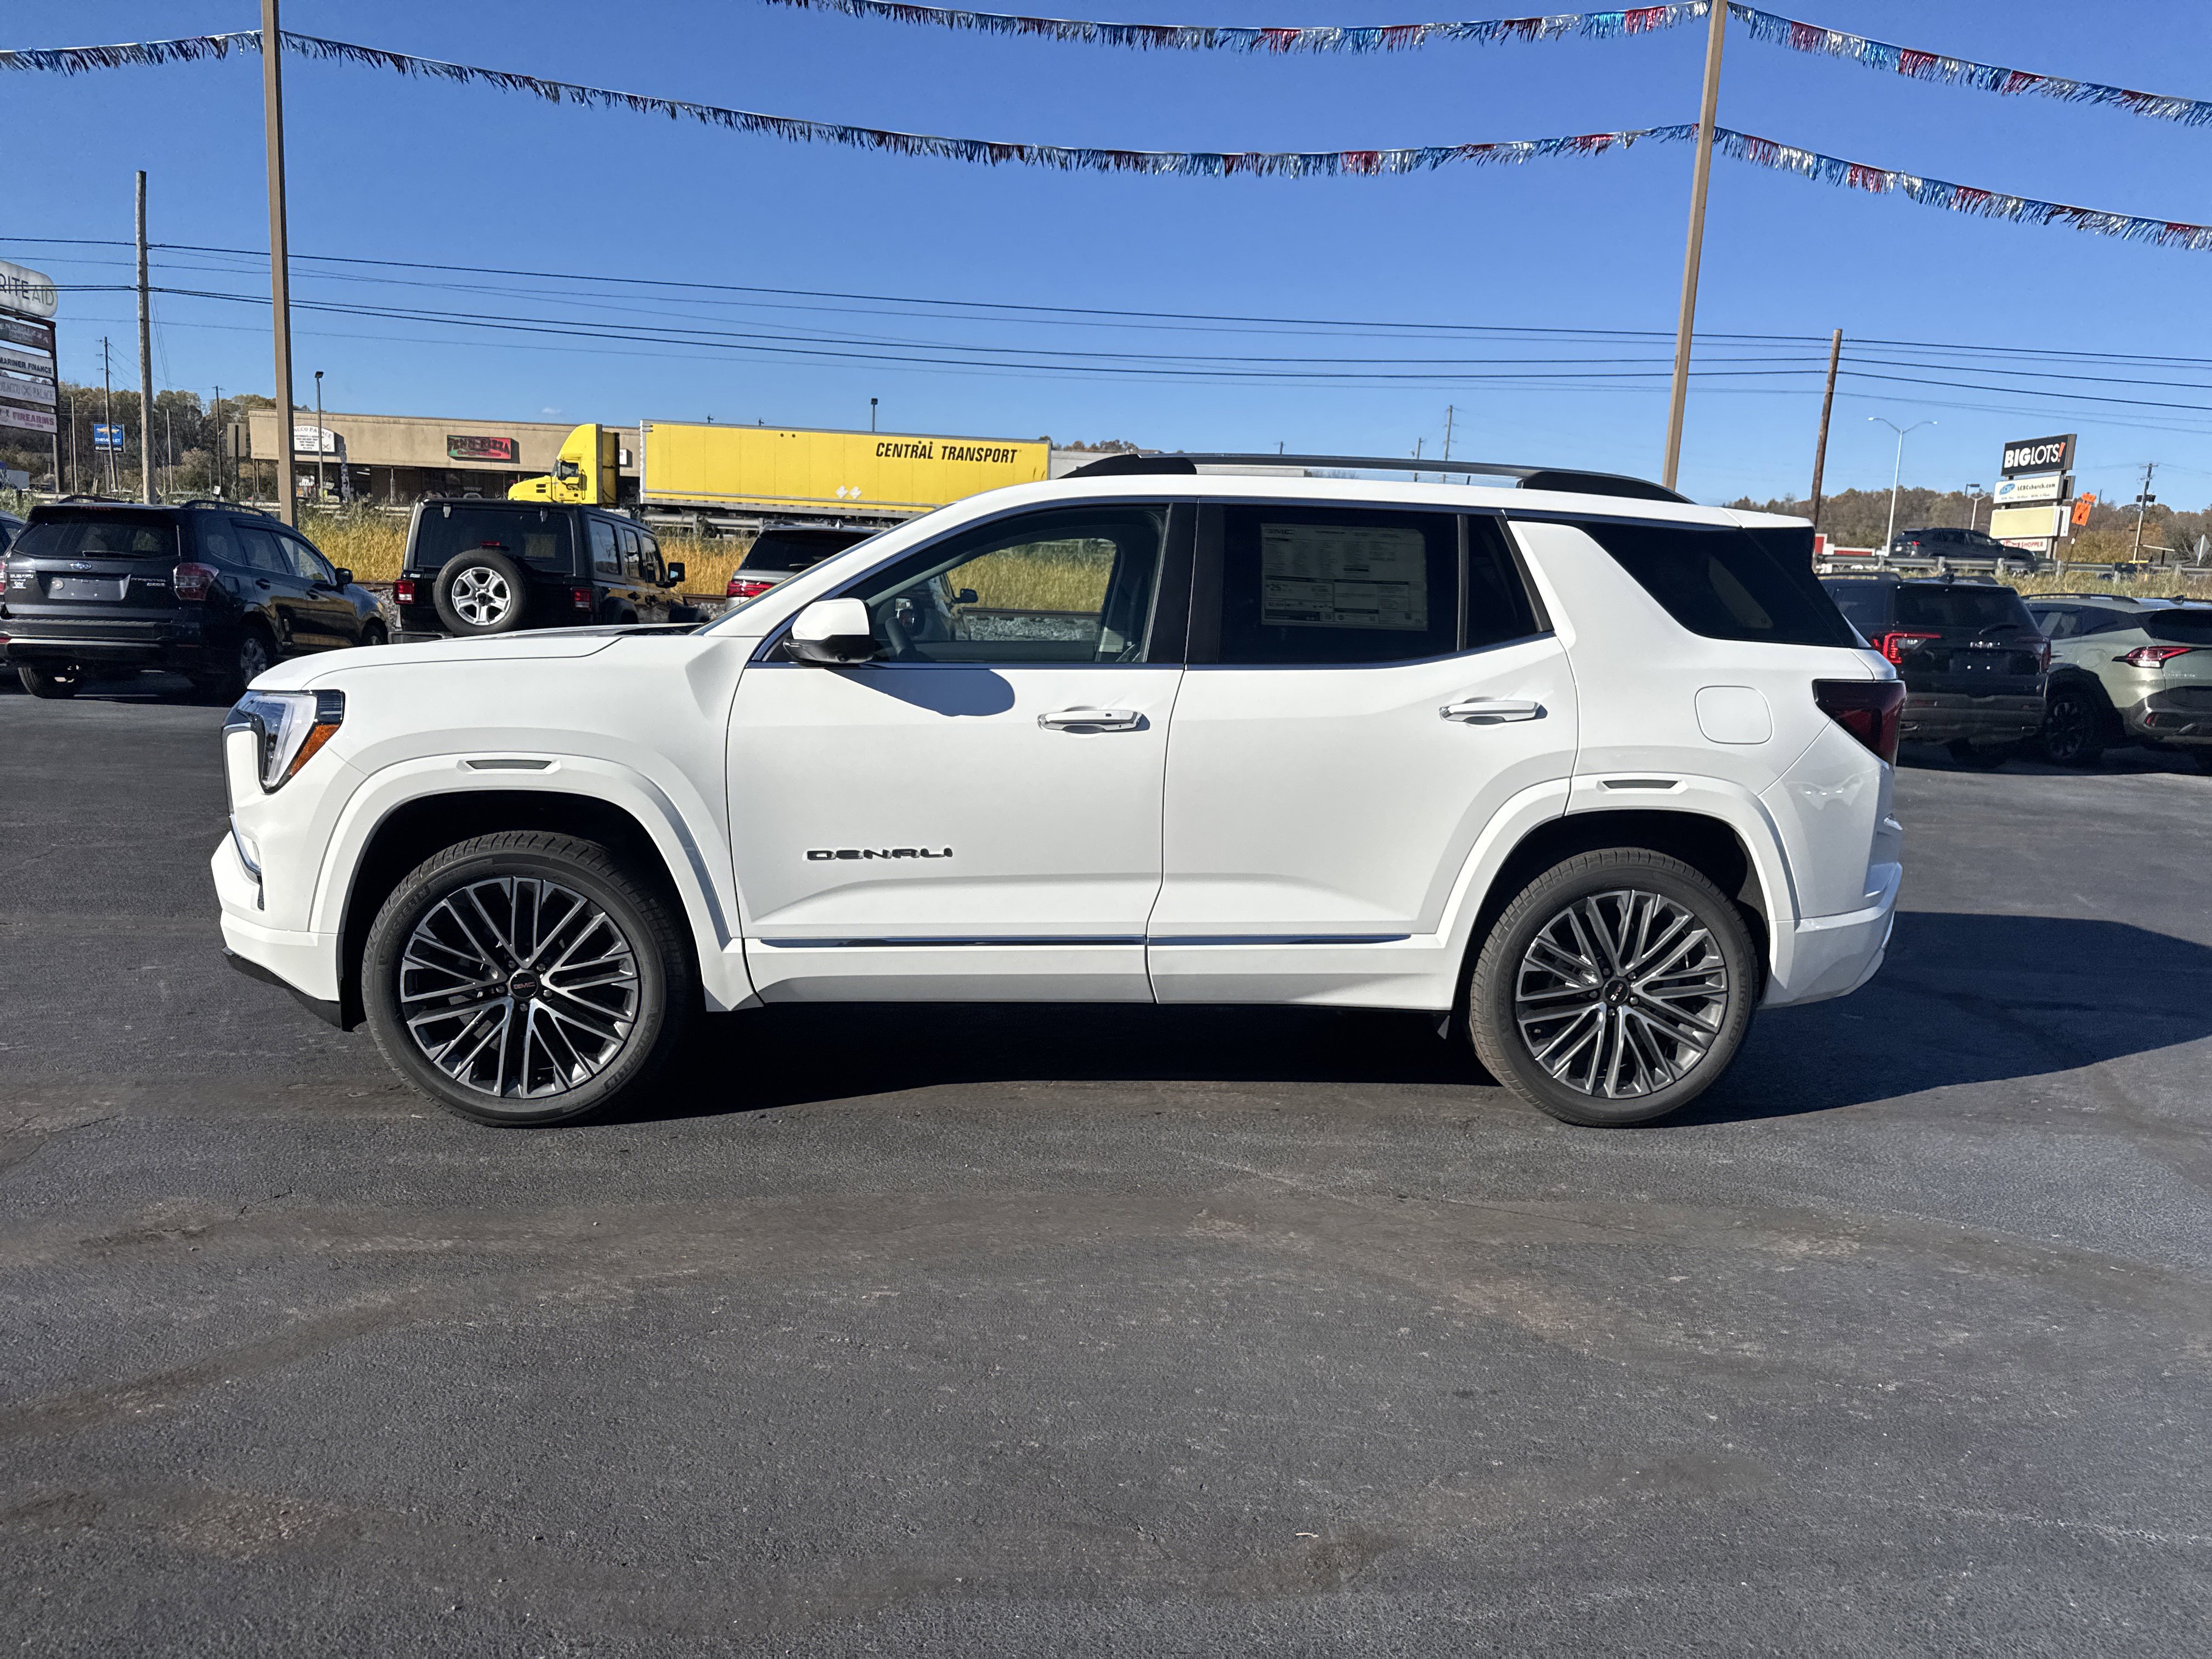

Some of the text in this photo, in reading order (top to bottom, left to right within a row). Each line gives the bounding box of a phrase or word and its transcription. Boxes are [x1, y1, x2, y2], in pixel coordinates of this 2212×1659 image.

[32, 285, 54, 306] AID
[28, 363, 52, 374] FINANCE
[12, 412, 54, 426] FIREARMS
[309, 427, 332, 439] PAACE
[876, 442, 1018, 464] CENTRAL TRANSPORT
[807, 848, 953, 861] DENALI
